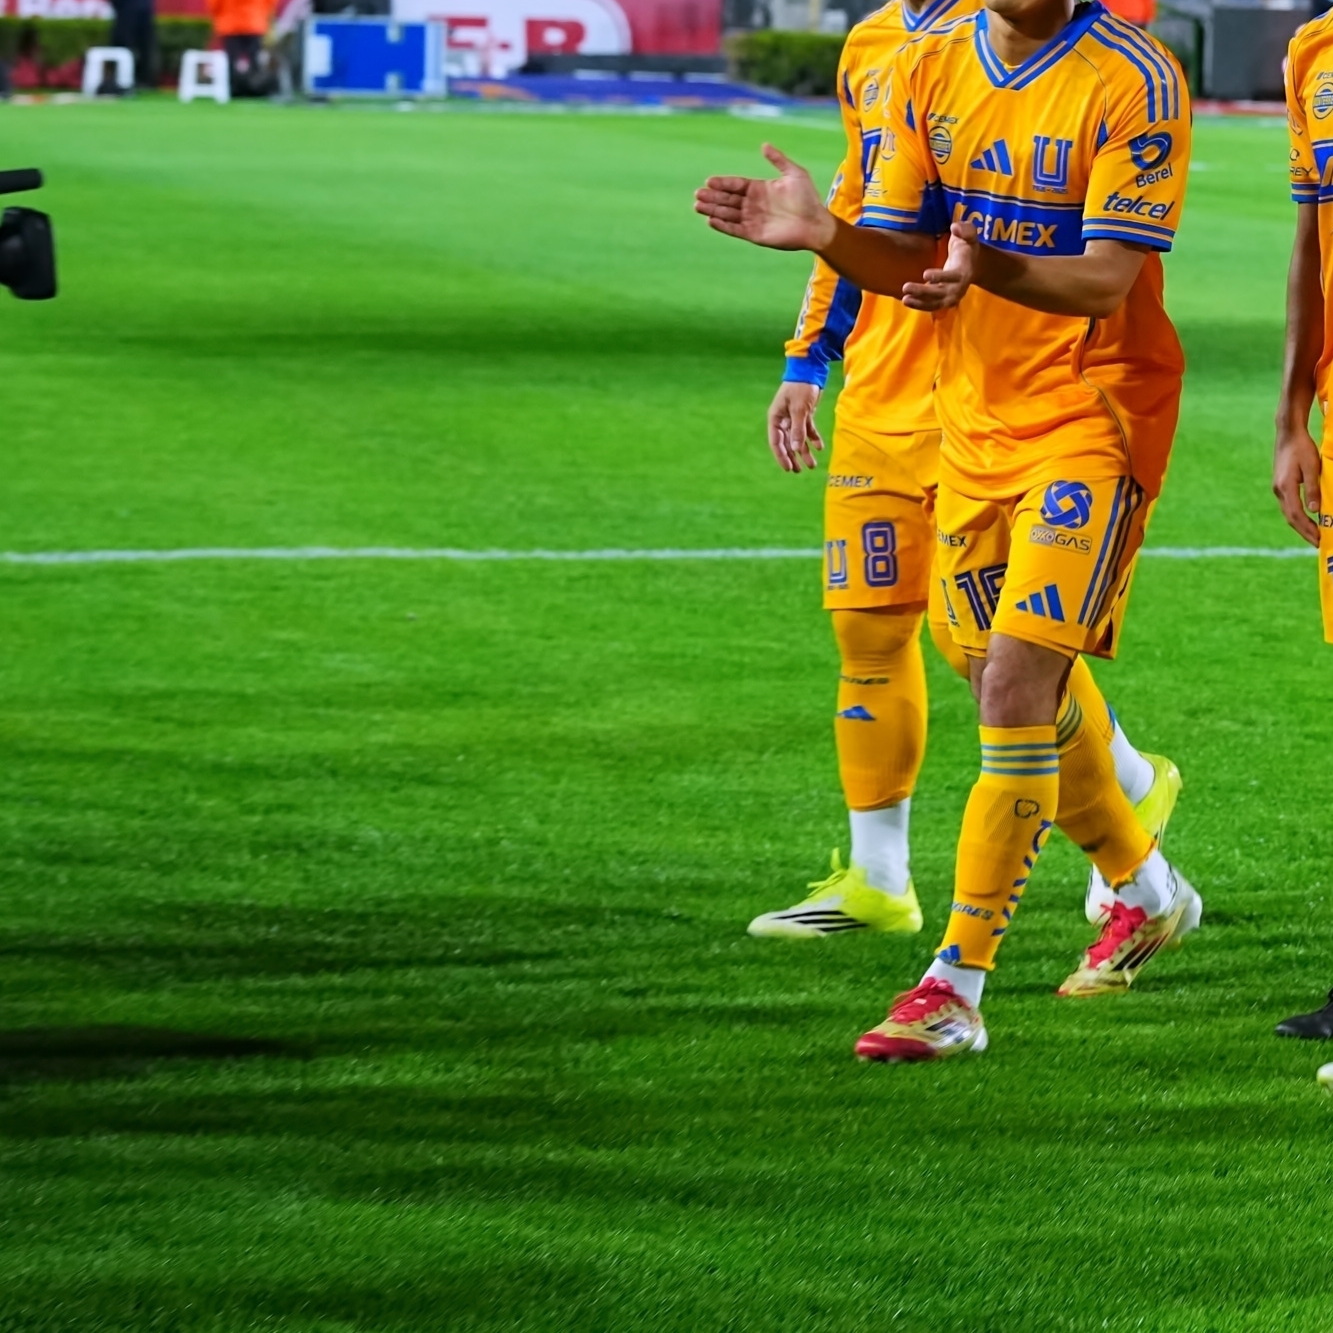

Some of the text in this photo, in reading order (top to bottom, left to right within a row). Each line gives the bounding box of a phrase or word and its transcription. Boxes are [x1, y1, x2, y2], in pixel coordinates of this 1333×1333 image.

[1033, 135, 1074, 187] U
[1135, 162, 1173, 188] Berel
[1103, 191, 1175, 220] telcel
[861, 520, 899, 587] 8
[1055, 532, 1091, 551] GAS
